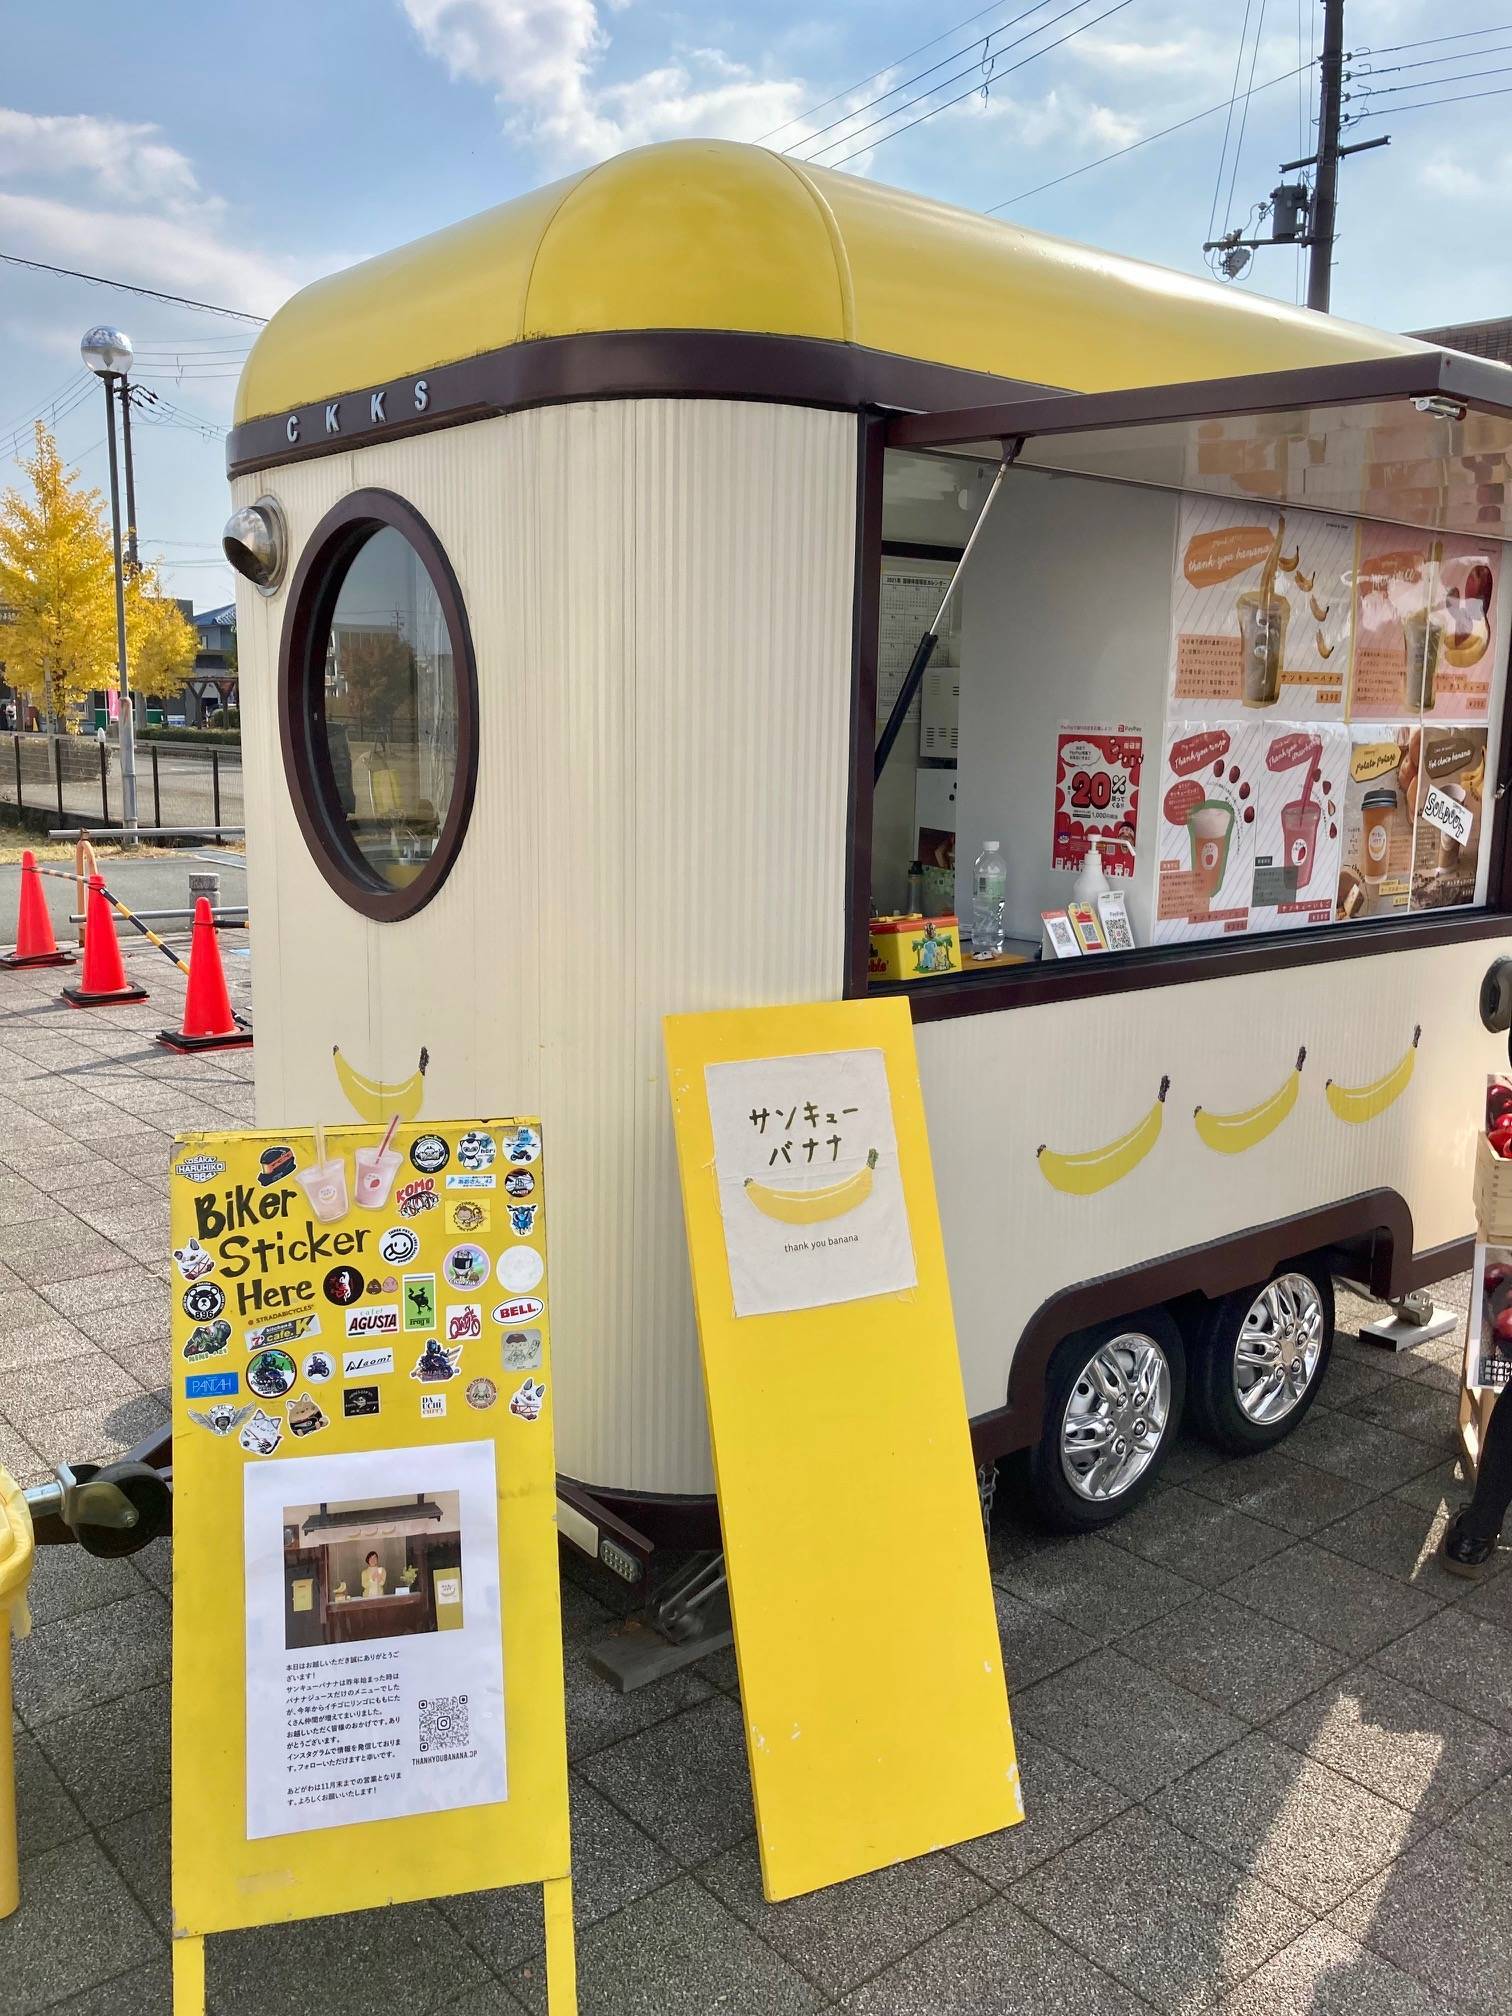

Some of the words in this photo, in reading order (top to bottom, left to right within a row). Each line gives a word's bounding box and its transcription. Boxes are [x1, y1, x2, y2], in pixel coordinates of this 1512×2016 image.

[749, 1101, 859, 1134] サンキュー
[768, 1134, 842, 1166] バナナ
[177, 1162, 223, 1174] HARUHIKO
[395, 1177, 435, 1203] KOMO
[194, 1185, 298, 1241] Biker
[219, 1221, 372, 1279] Sticker
[783, 1240, 810, 1253] thank
[811, 1238, 826, 1251] you
[827, 1233, 859, 1247] banana
[237, 1279, 316, 1317] Here
[194, 1310, 214, 1319] 896
[349, 1313, 398, 1332] AGUSTA
[286, 1736, 341, 1750] がとうございます。
